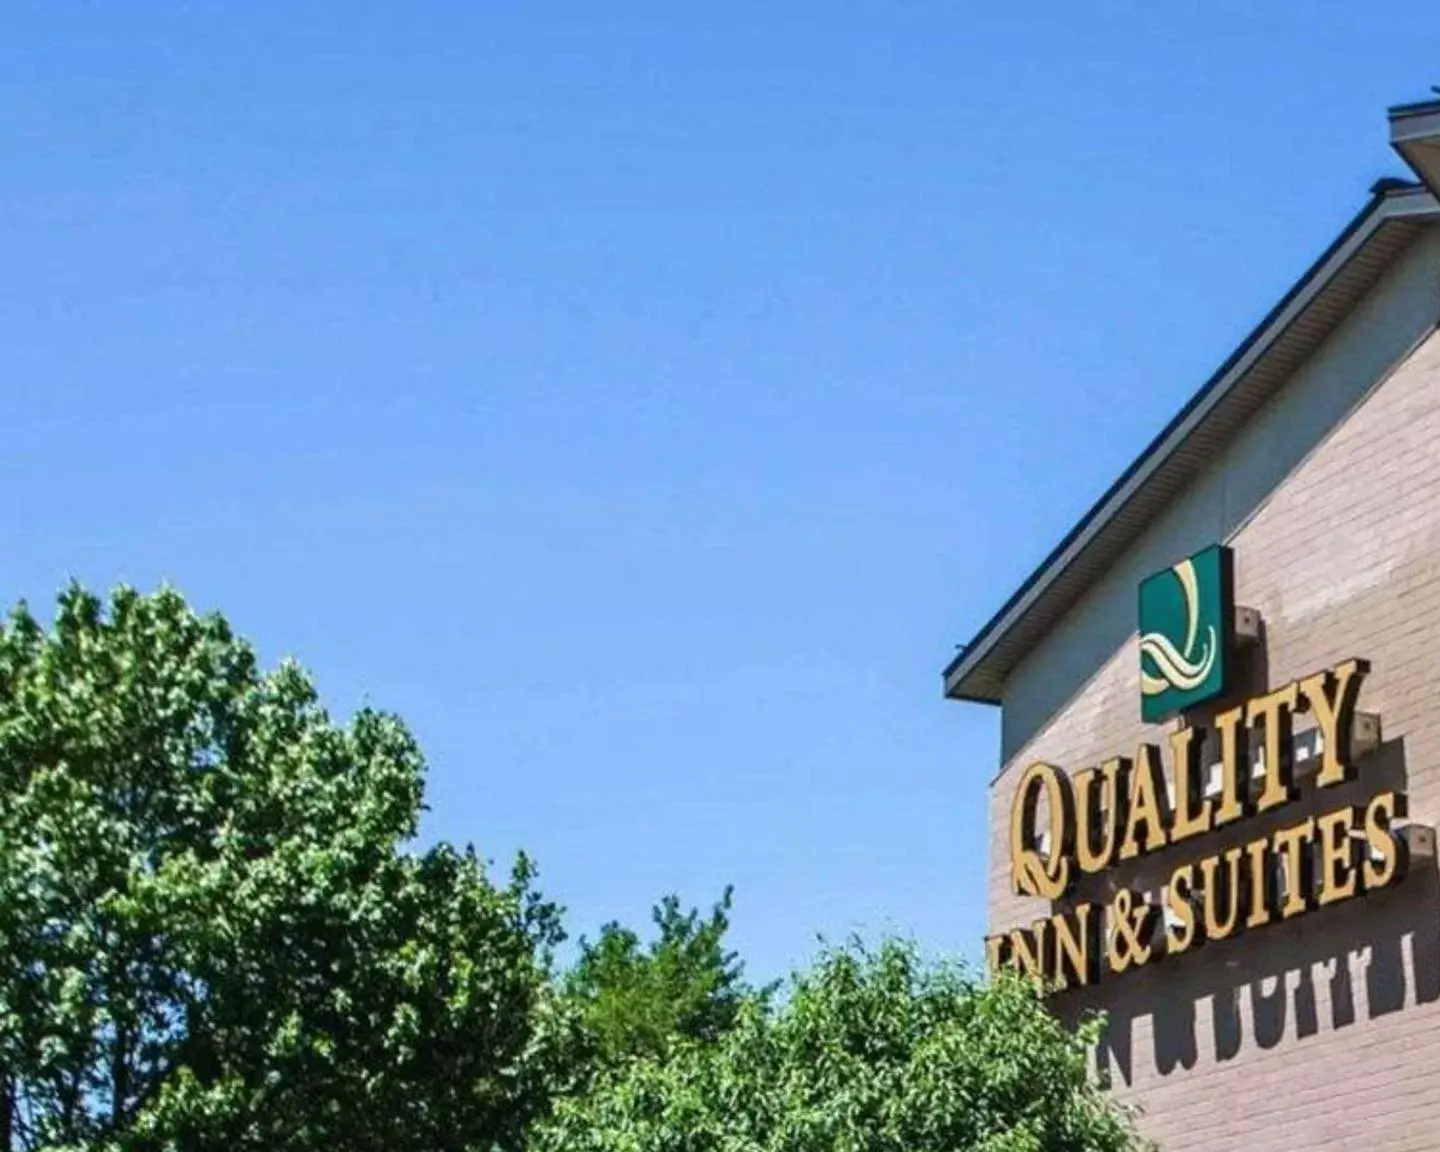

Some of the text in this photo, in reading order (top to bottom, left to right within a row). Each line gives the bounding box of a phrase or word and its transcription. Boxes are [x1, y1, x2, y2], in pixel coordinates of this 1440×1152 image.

[1011, 657, 1368, 900] QUALITY
[1107, 887, 1152, 973] &
[1165, 791, 1401, 955] SUITES
